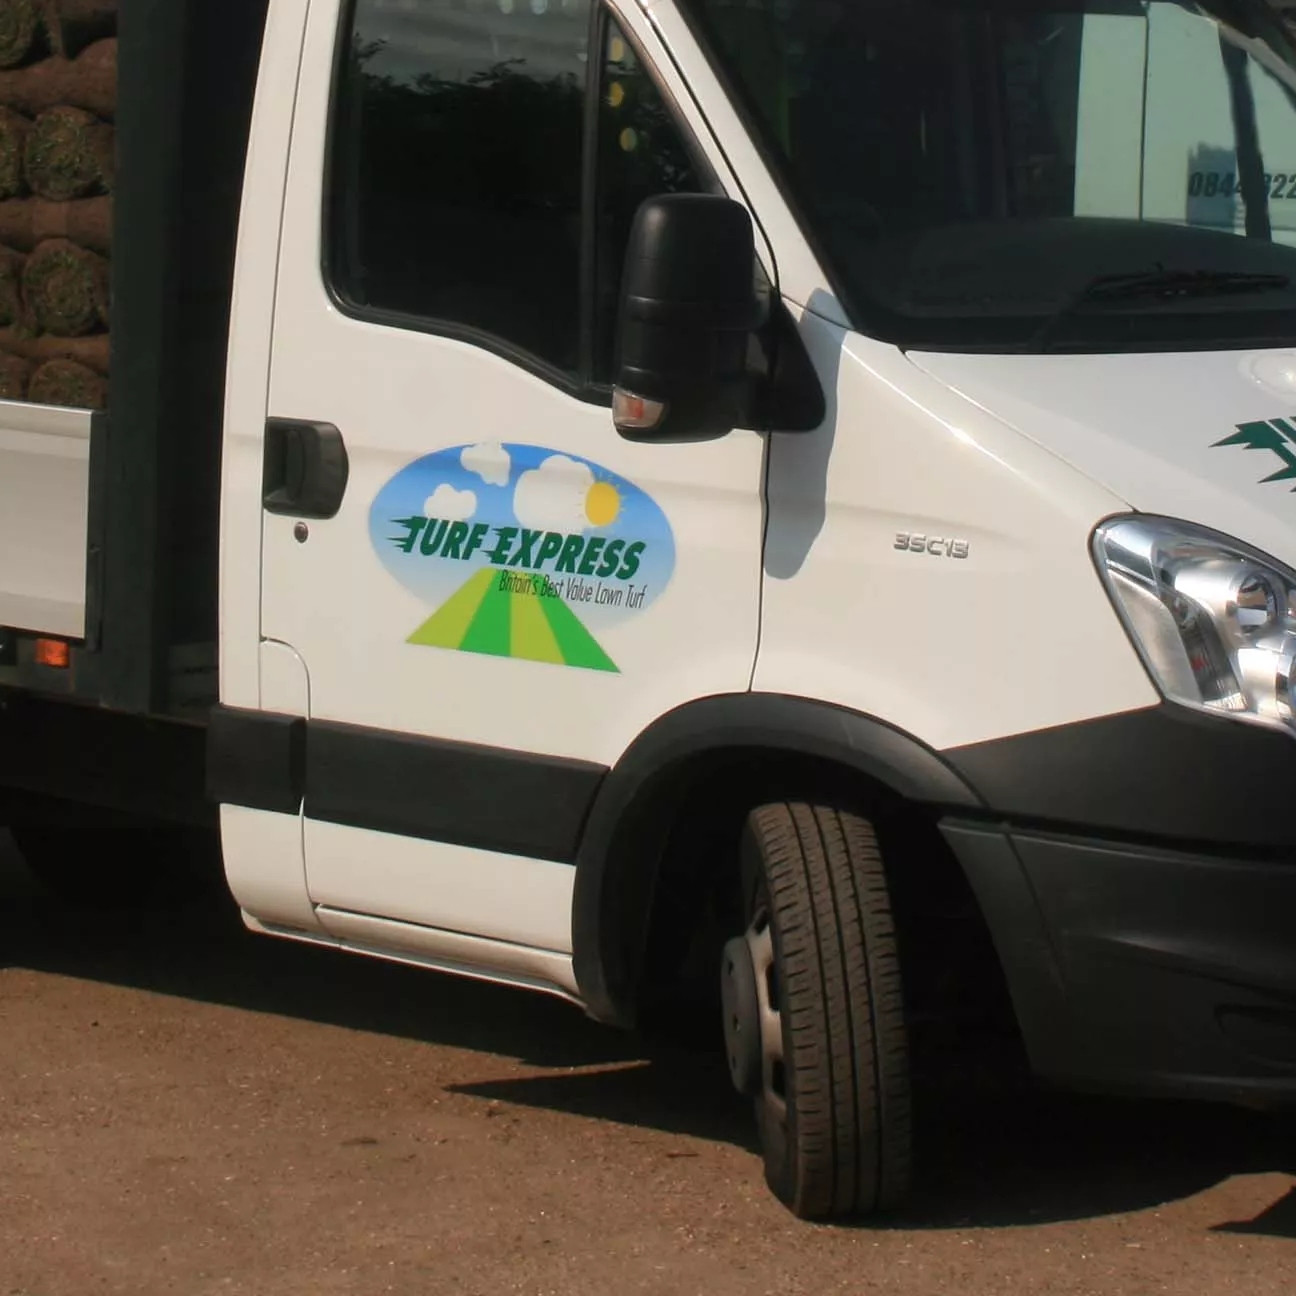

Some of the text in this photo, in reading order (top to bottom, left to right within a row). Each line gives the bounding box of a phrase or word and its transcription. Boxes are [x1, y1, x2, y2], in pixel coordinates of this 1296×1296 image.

[386, 515, 647, 580] TURF EXPRESS
[893, 531, 970, 559] 35C13
[540, 574, 565, 598] Best
[565, 578, 593, 602] Value
[594, 581, 624, 606] Lawn
[624, 584, 648, 609] Turf
